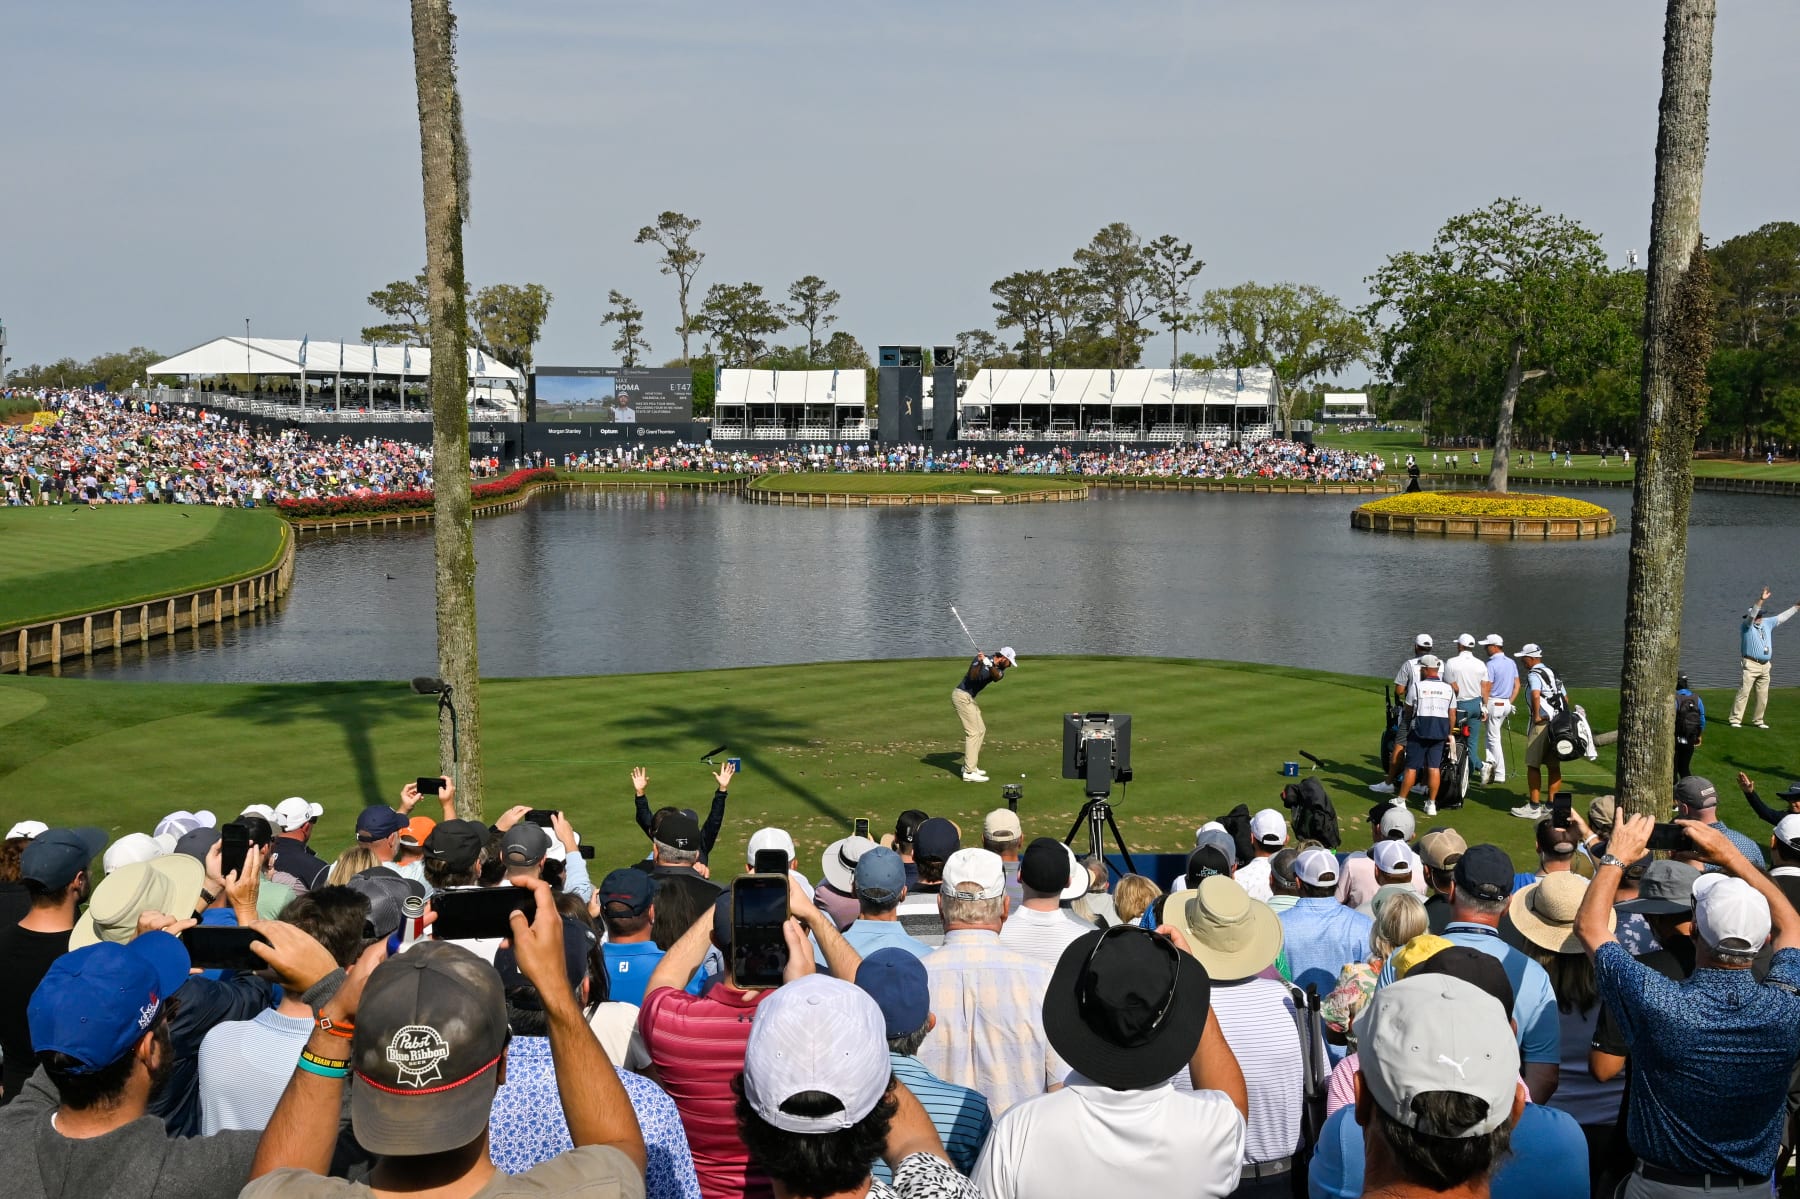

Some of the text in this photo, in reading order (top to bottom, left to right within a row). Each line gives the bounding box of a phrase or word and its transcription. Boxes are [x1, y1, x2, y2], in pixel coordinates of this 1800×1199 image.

[600, 428, 619, 436] Optum
[618, 961, 629, 973] FJ
[400, 1032, 431, 1049] Pabst
[390, 1047, 447, 1061] Blue Ribbon
